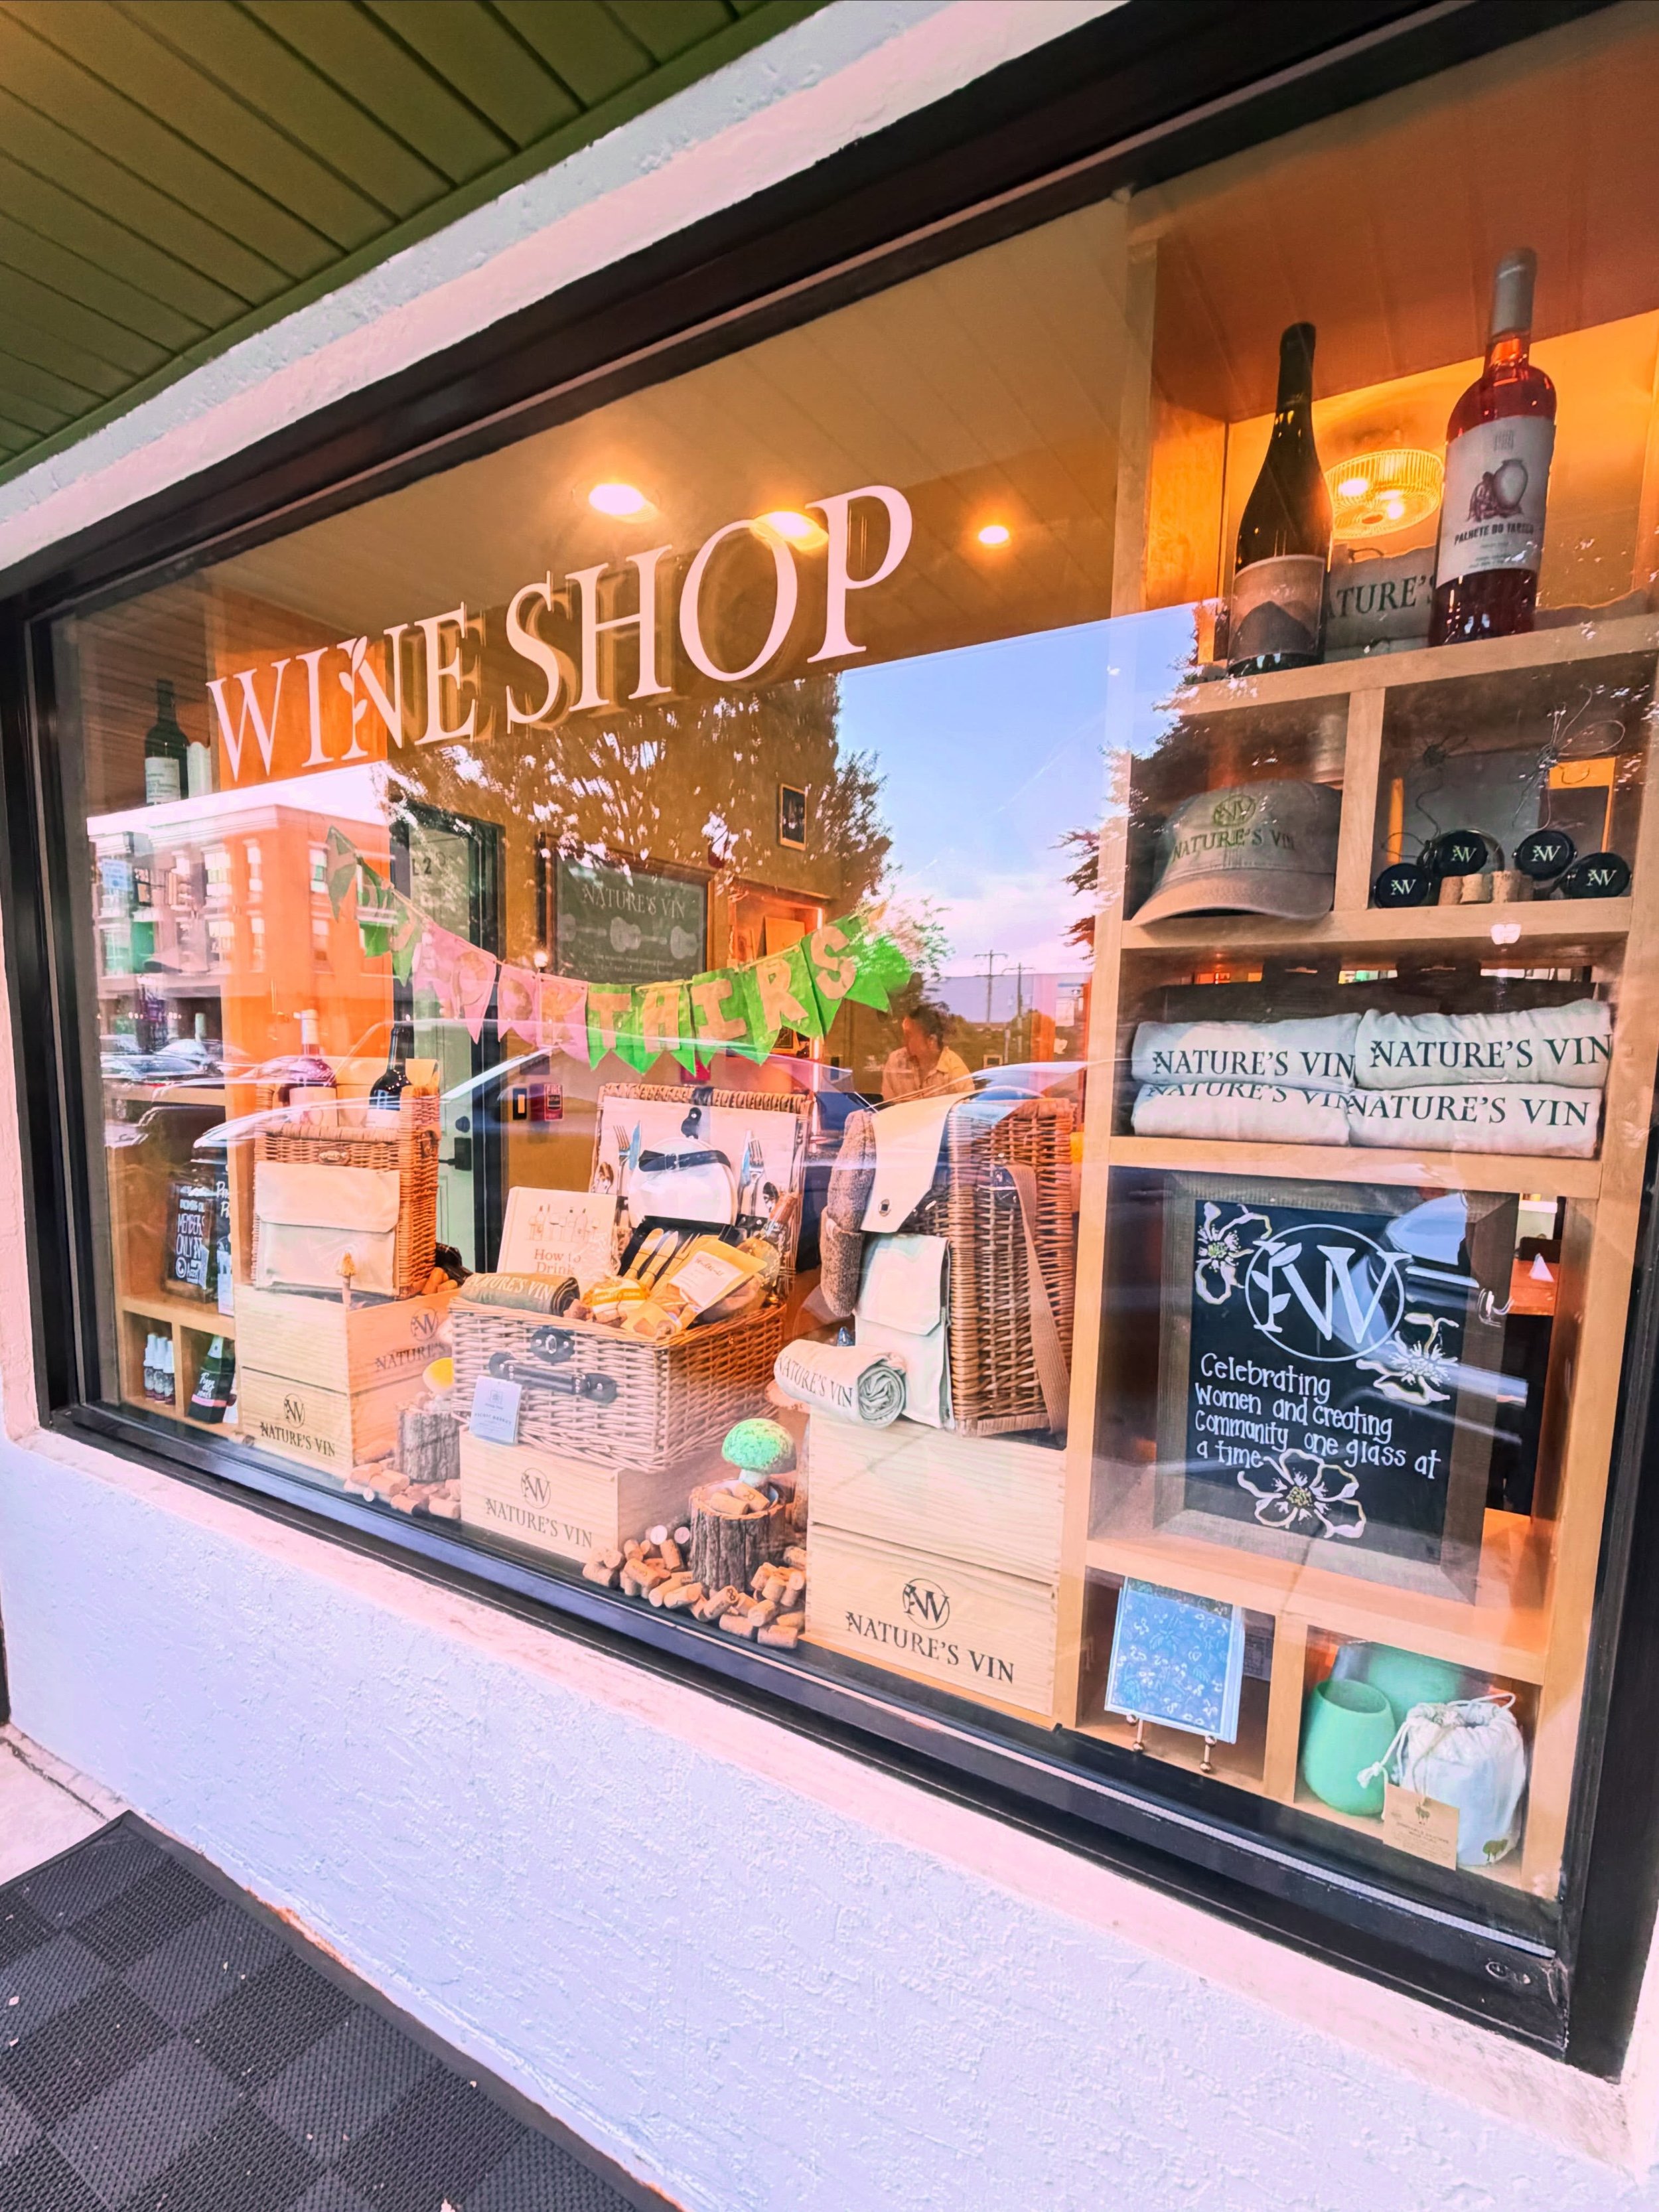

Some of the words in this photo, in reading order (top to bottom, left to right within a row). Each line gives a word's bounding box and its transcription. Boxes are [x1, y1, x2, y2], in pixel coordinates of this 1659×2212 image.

[1455, 525, 1489, 546] PALHETE
[1492, 524, 1503, 534] DO
[1329, 575, 1434, 619] TURE'
[206, 602, 475, 781] WINE
[507, 485, 912, 733] SHOP
[1172, 829, 1262, 863] NATURE'S
[582, 885, 656, 915] NATURE'S
[661, 897, 685, 919] VIN
[1152, 1049, 1288, 1076] NATURE'S
[1299, 1052, 1355, 1079] VIN
[1370, 1038, 1532, 1068] NATURE'S
[1543, 1034, 1613, 1065] VIN
[1344, 1094, 1506, 1124] NATURE'S
[1520, 1098, 1591, 1127] VIN
[534, 1248, 565, 1262] How
[469, 1274, 528, 1293] NATURE'S
[528, 1282, 553, 1301] VIN
[774, 1353, 826, 1397] NATURE'S
[831, 1380, 853, 1408] VIN
[1200, 1353, 1331, 1404] Celebrating
[1196, 1382, 1262, 1415] Women
[1273, 1397, 1308, 1426] and
[259, 1422, 312, 1450] NATURE'S
[315, 1436, 336, 1457] VIN
[1196, 1410, 1288, 1451] Community
[1304, 1433, 1338, 1456] one
[1344, 1439, 1406, 1467] glass
[1415, 1449, 1441, 1479] at
[1197, 1441, 1208, 1459] a
[1214, 1440, 1263, 1468] time
[485, 1497, 557, 1537] NATURE'S
[563, 1523, 592, 1548] VIN
[845, 1611, 959, 1666] NATURE'S
[968, 1649, 1013, 1684] VIN
